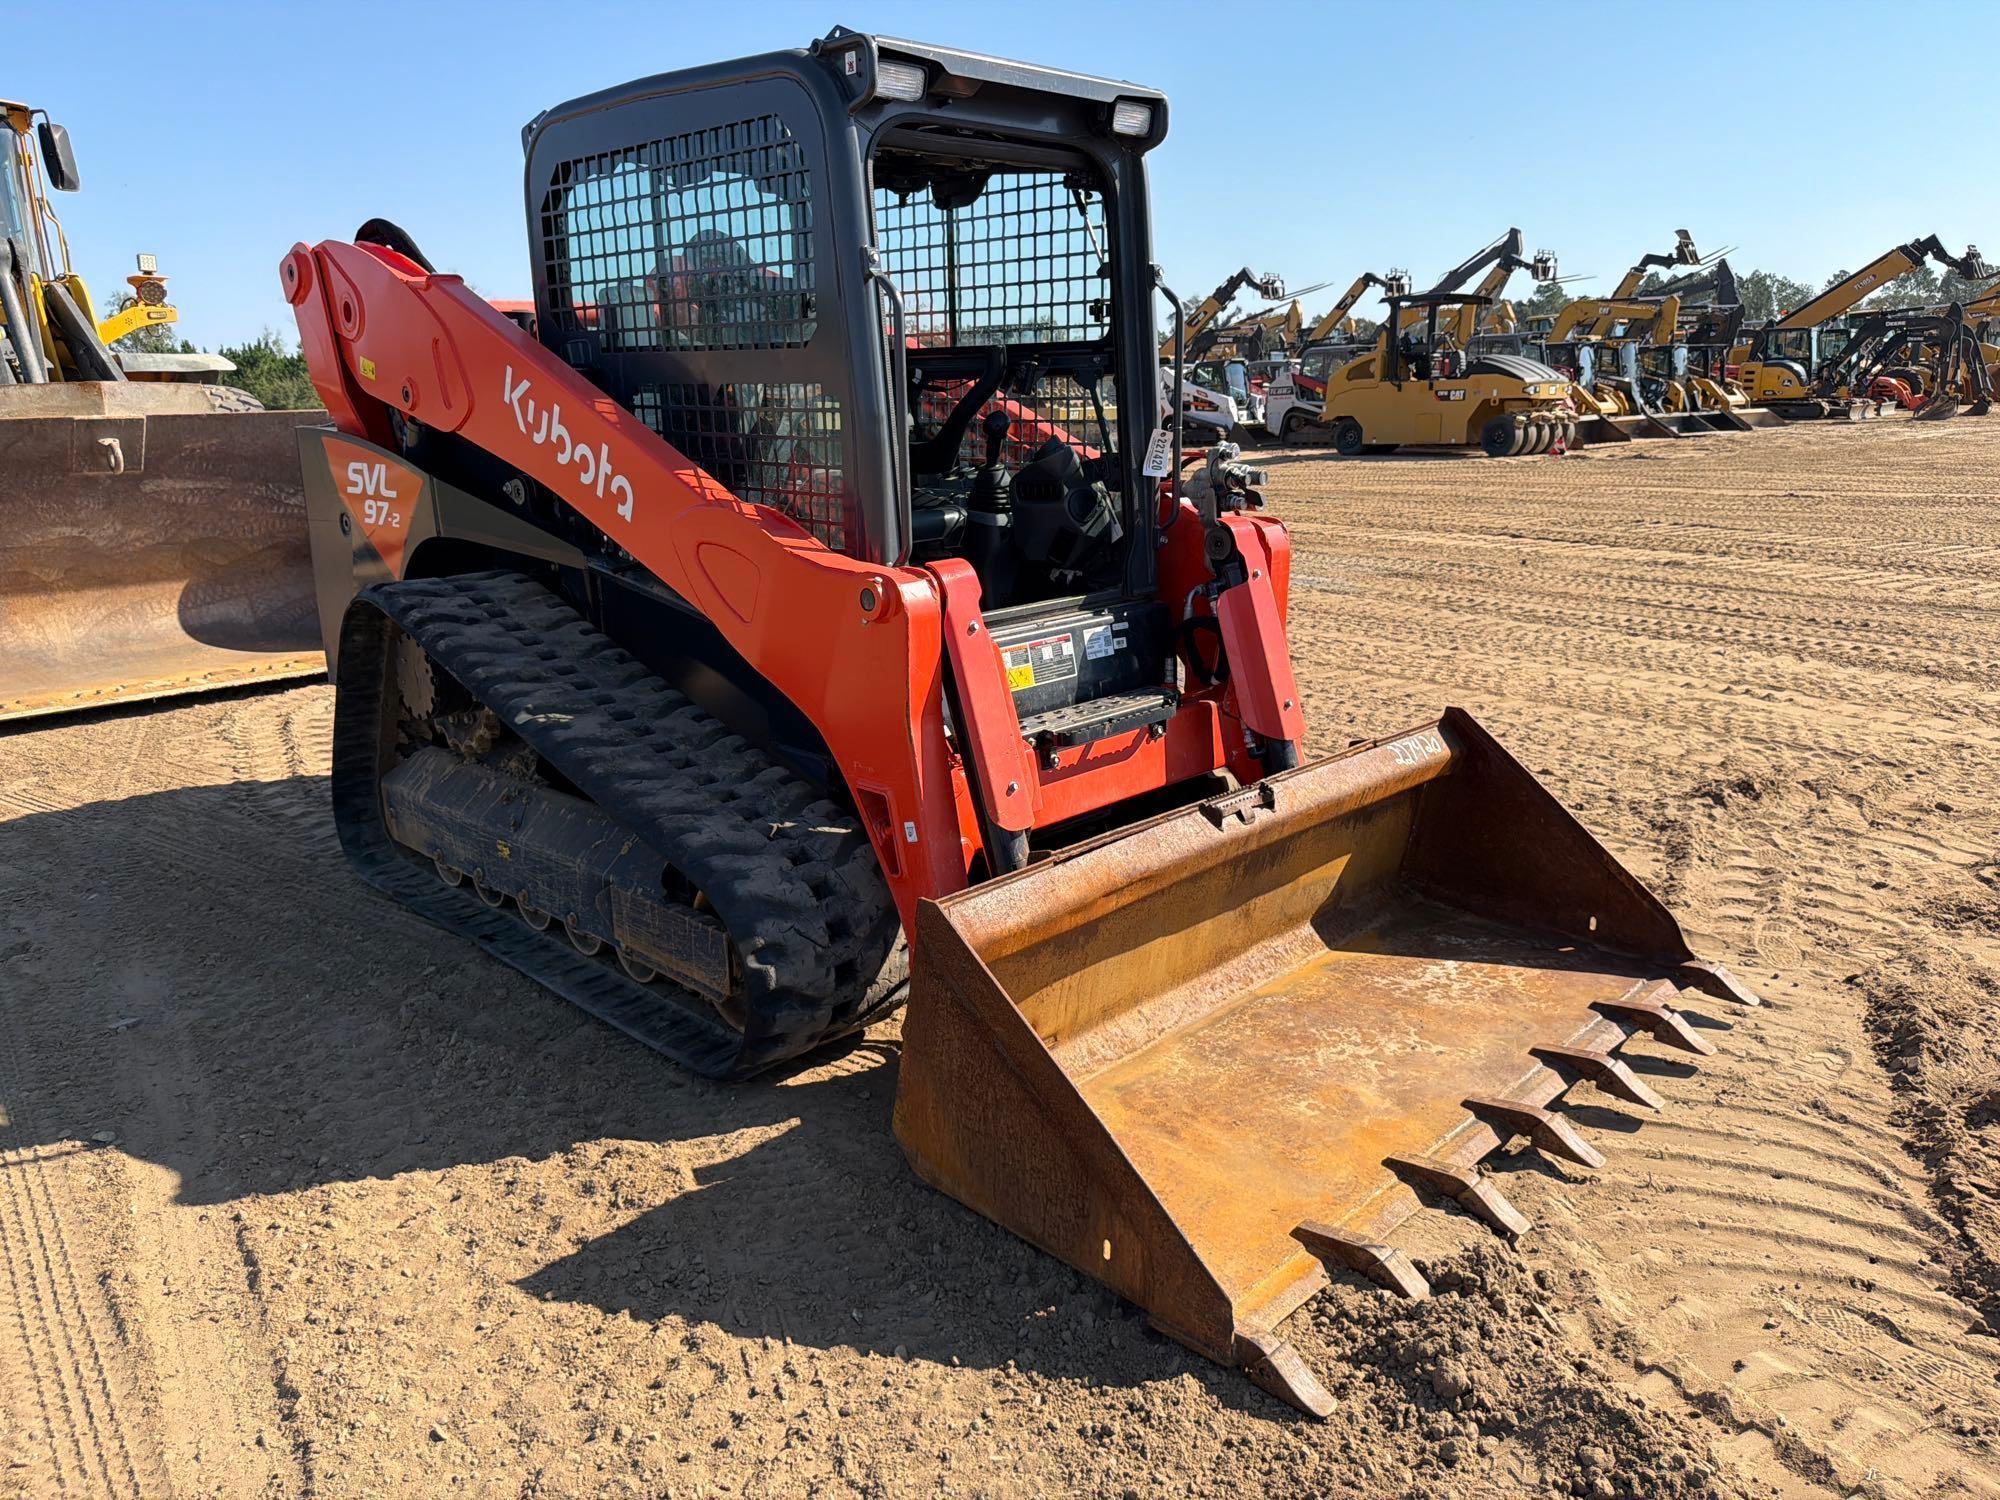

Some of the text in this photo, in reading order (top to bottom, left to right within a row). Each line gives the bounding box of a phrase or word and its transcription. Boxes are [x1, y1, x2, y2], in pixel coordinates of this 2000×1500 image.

[1450, 390, 1464, 401] CAT
[503, 364, 634, 524] Kubota
[1151, 438, 1168, 471] 227420
[346, 461, 397, 498] SVL
[1386, 735, 1442, 765] 227420
